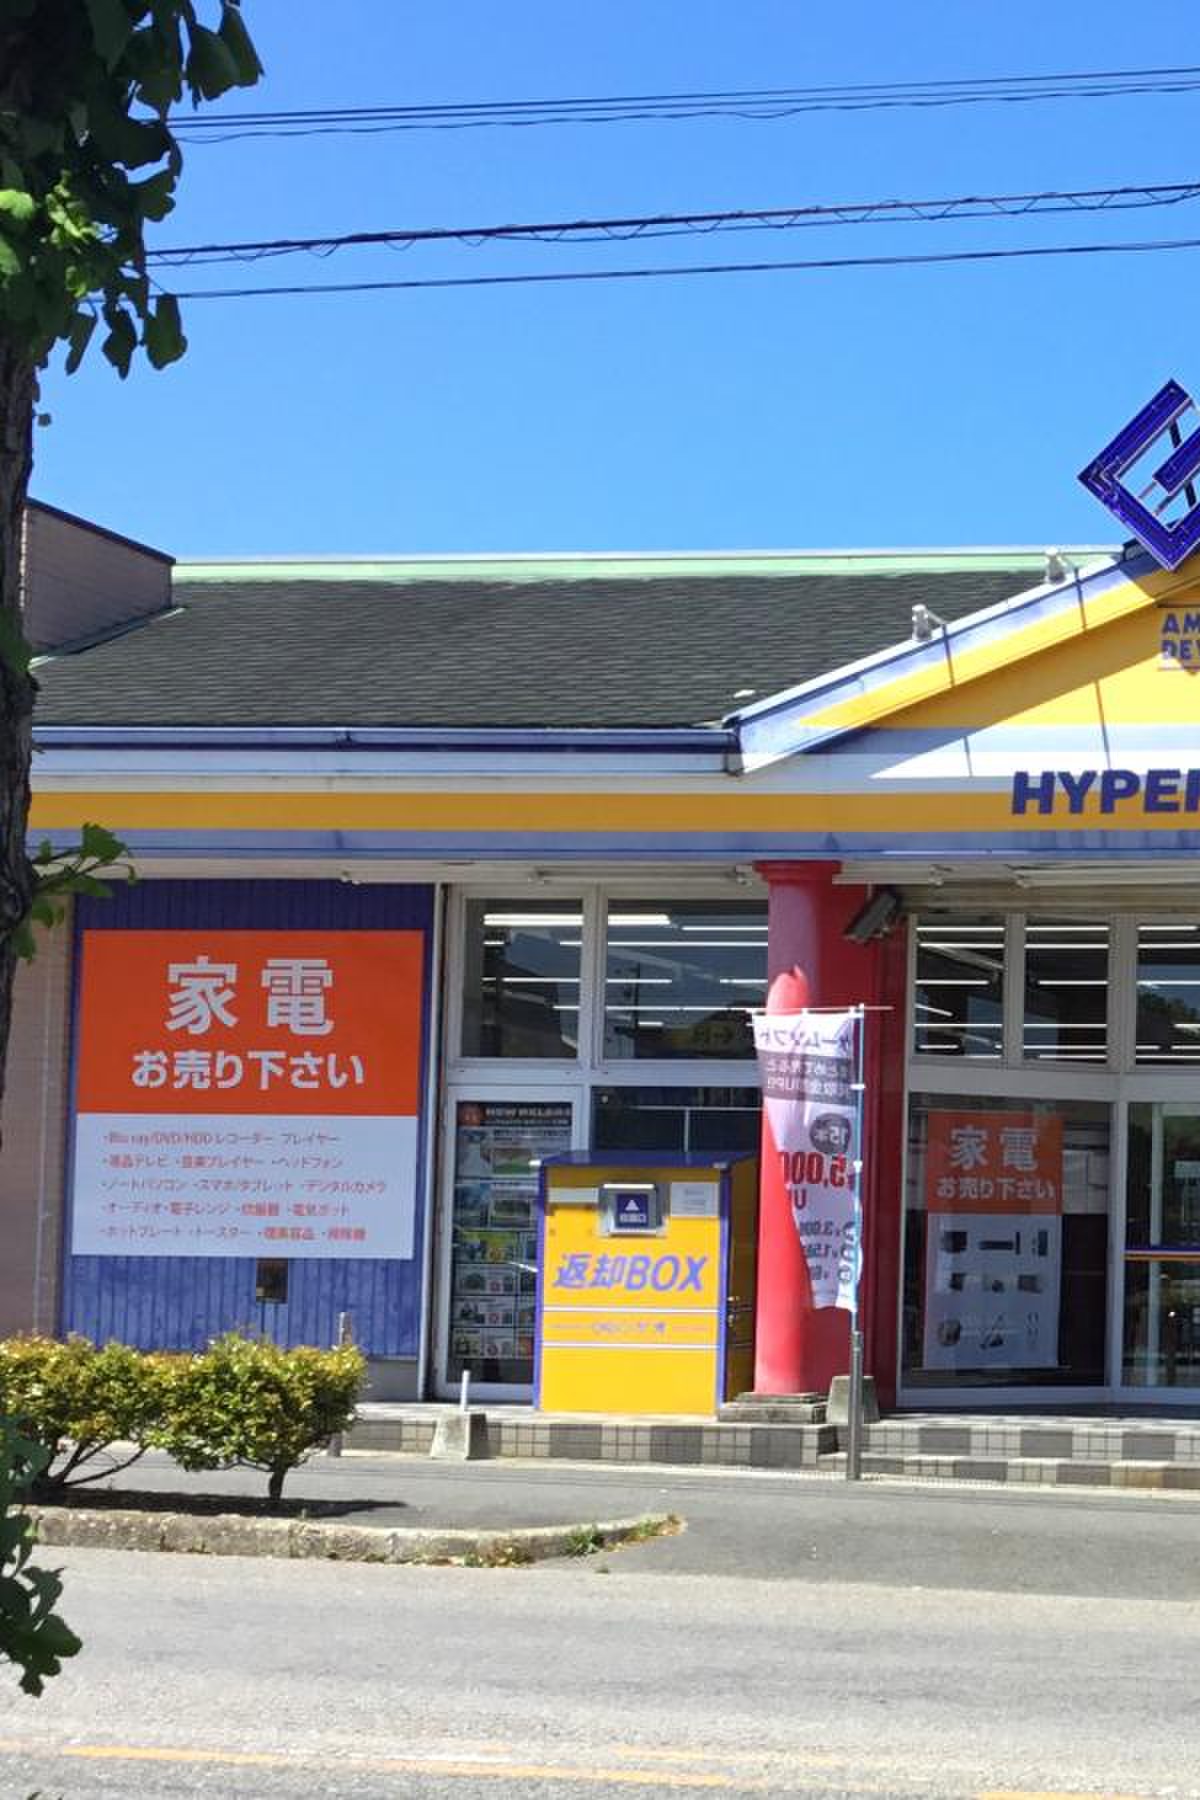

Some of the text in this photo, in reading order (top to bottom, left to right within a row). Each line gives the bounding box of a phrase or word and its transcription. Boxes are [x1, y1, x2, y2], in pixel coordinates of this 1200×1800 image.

[164, 955, 335, 1036] 家電
[131, 1049, 366, 1091] お売り下さい
[950, 1126, 1040, 1172] 家電
[936, 1176, 1056, 1200] お売り下さい
[552, 1253, 708, 1293] 返却BOX
